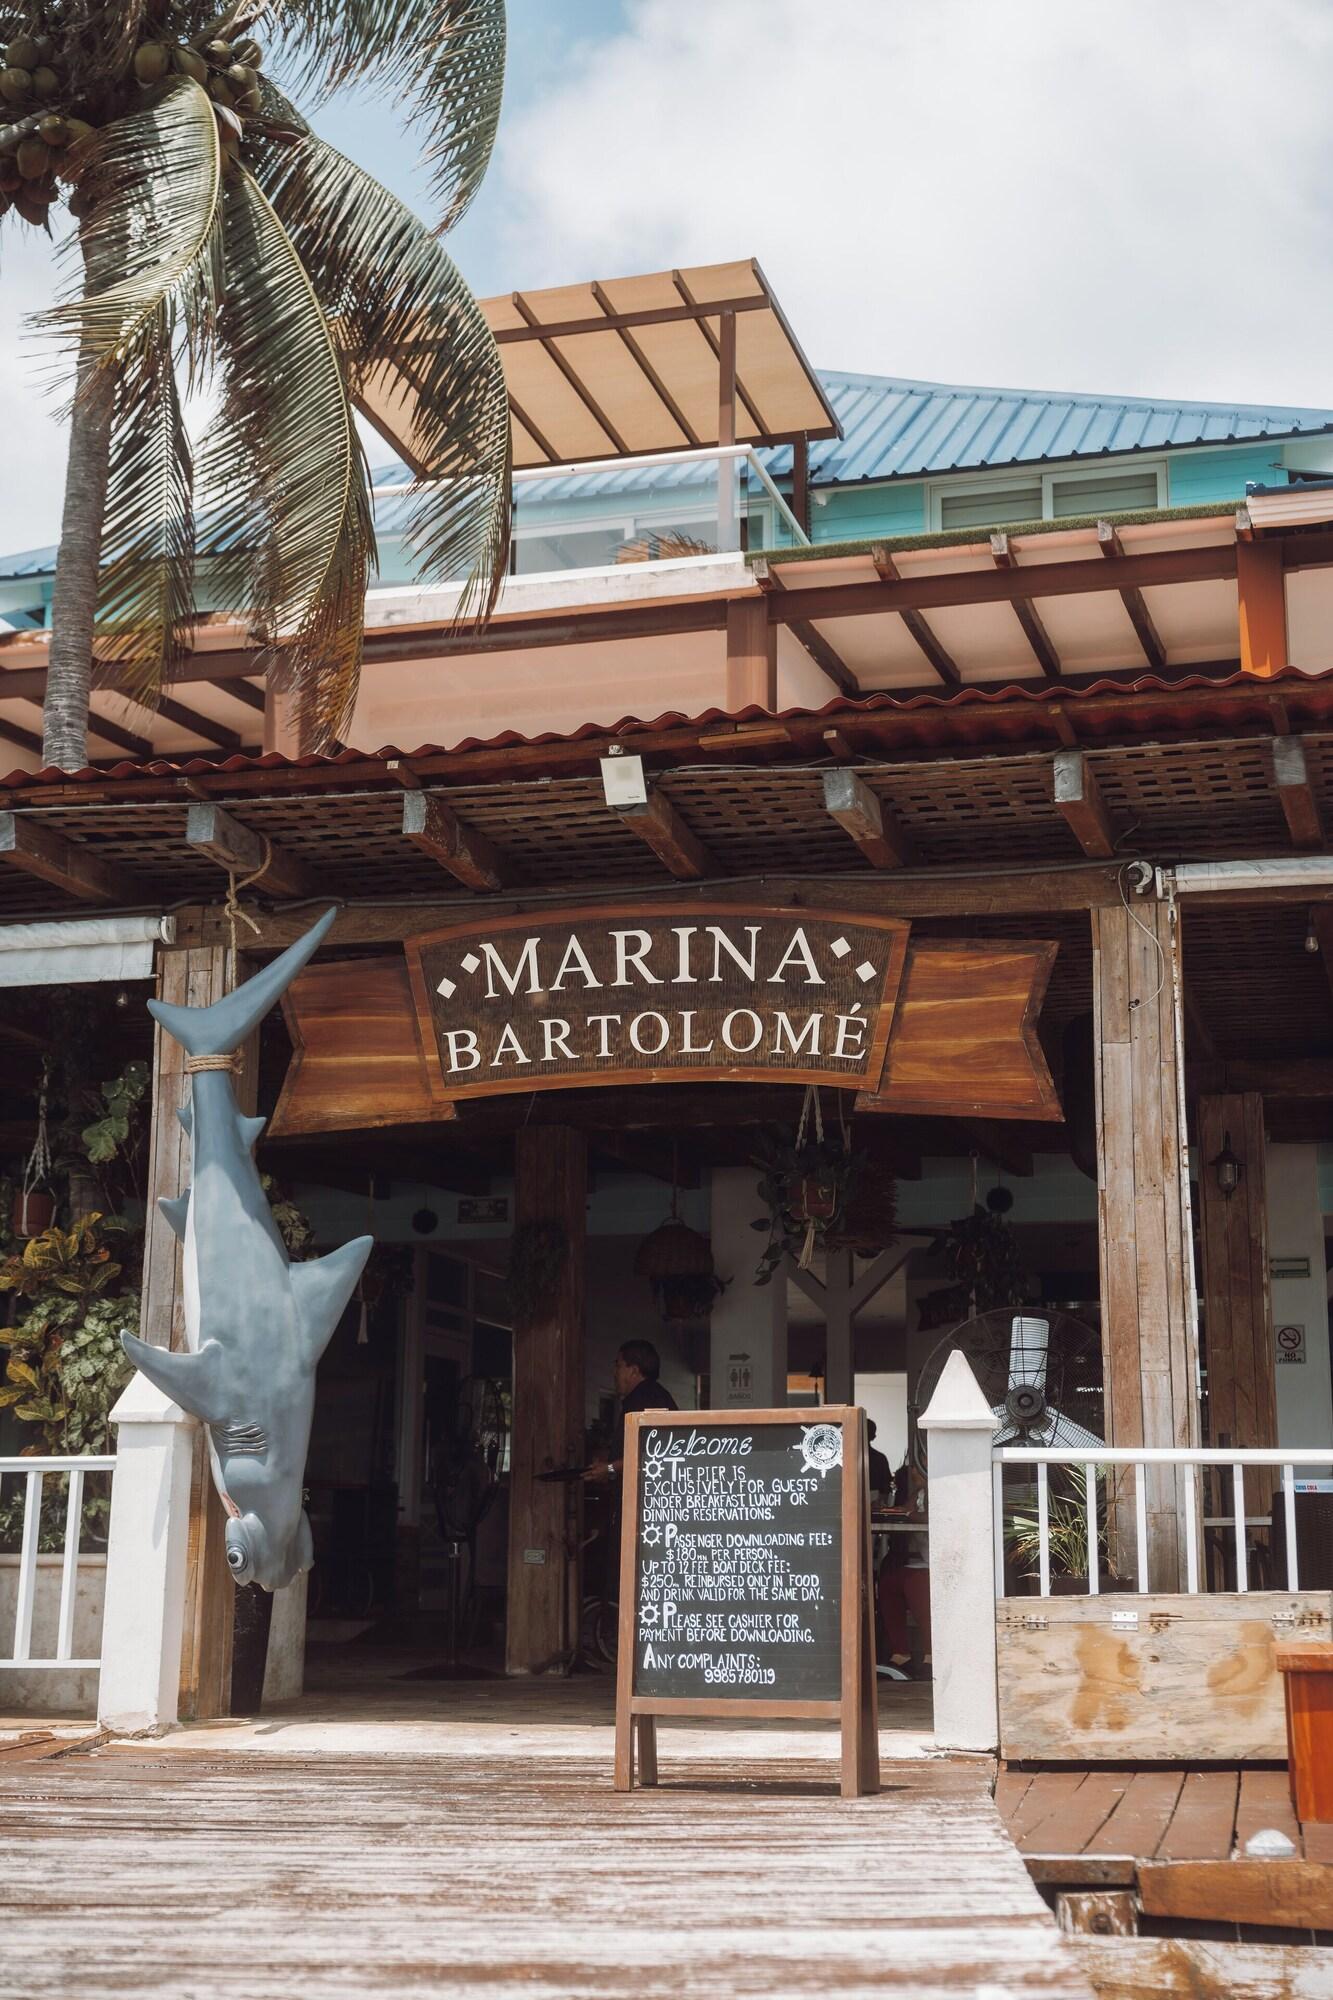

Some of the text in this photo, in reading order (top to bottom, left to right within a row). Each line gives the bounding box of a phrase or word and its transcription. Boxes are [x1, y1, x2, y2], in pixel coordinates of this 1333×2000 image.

[479, 927, 826, 998] MARINA
[443, 1003, 869, 1074] BARTOLOMÉ
[663, 1457, 745, 1481] THE PIER IS
[644, 1479, 818, 1495] EXCLUSIVELY FOR GUESTS
[644, 1496, 682, 1509] UNDER
[749, 1494, 781, 1506] LUNCH
[790, 1493, 808, 1505] OR
[644, 1508, 775, 1522] DINNING RESERVATIONS.
[665, 1524, 832, 1548] PASSENGER DOWNLOADING FEE:
[712, 1550, 730, 1561] PER
[734, 1548, 778, 1560] PERSON.
[662, 1561, 675, 1574] TO
[679, 1561, 690, 1574] 12
[692, 1561, 709, 1574] FEE
[713, 1561, 738, 1574] BOAT
[740, 1561, 765, 1574] DECK
[768, 1560, 790, 1573] FEE:
[685, 1575, 744, 1588] REINBURSED
[747, 1575, 771, 1588] ONLY
[773, 1575, 783, 1587] IN
[789, 1574, 819, 1587] FOOD
[640, 1587, 824, 1601] AND DRINK VALID FOR THE SAME DAY.
[663, 1602, 799, 1629] PLEASE SEE CASHIER FOR
[639, 1628, 815, 1642] PAYMENT BEFORE DOWNLOADING.
[643, 1643, 760, 1670] ANY COMPLAINTS:
[704, 1669, 775, 1684] 9985780119
